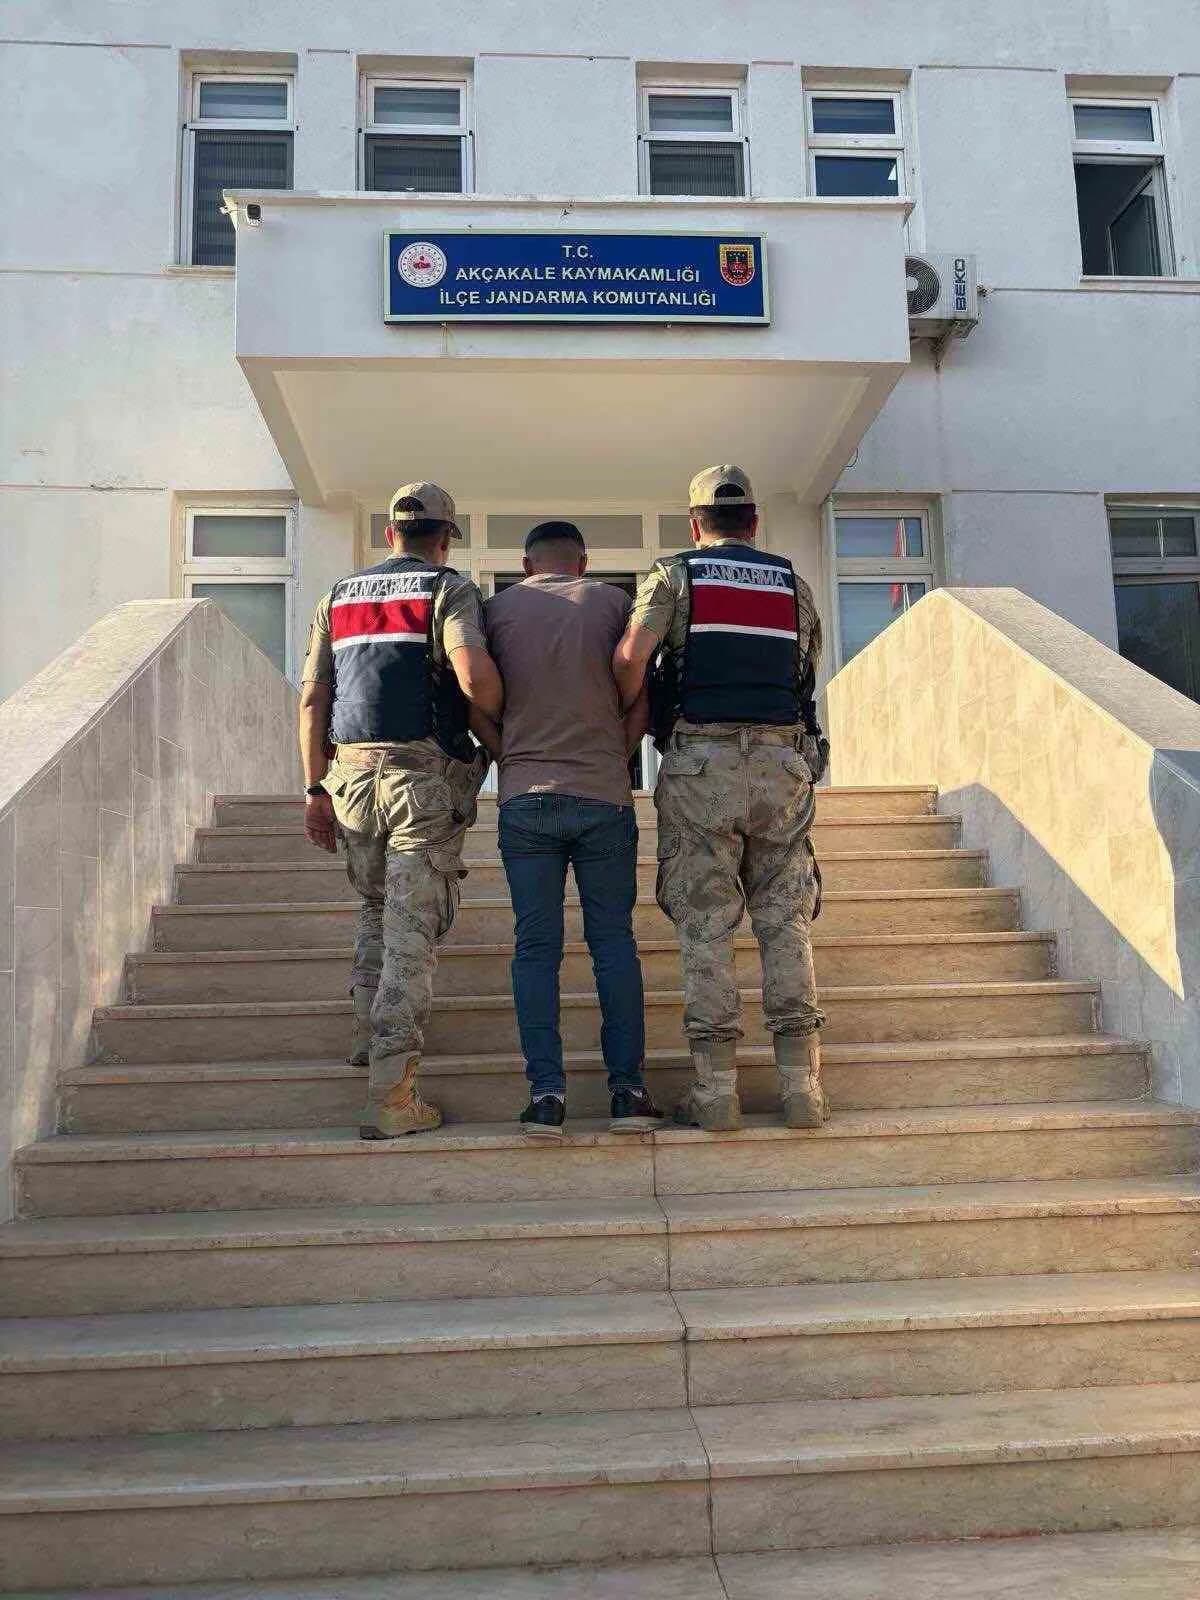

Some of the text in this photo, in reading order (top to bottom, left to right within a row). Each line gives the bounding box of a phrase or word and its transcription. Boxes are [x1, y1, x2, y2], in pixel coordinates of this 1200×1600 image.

[562, 245, 593, 258] T.C.
[455, 266, 556, 284] AKÇAKALE
[561, 265, 700, 283] KAYMAKAMLIĞI
[954, 258, 967, 311] BEKO
[439, 289, 716, 307] İLÇE JANDARMA KOMUTANLIĞI
[701, 564, 787, 588] JANDARMA
[342, 576, 422, 599] JANDARMA
